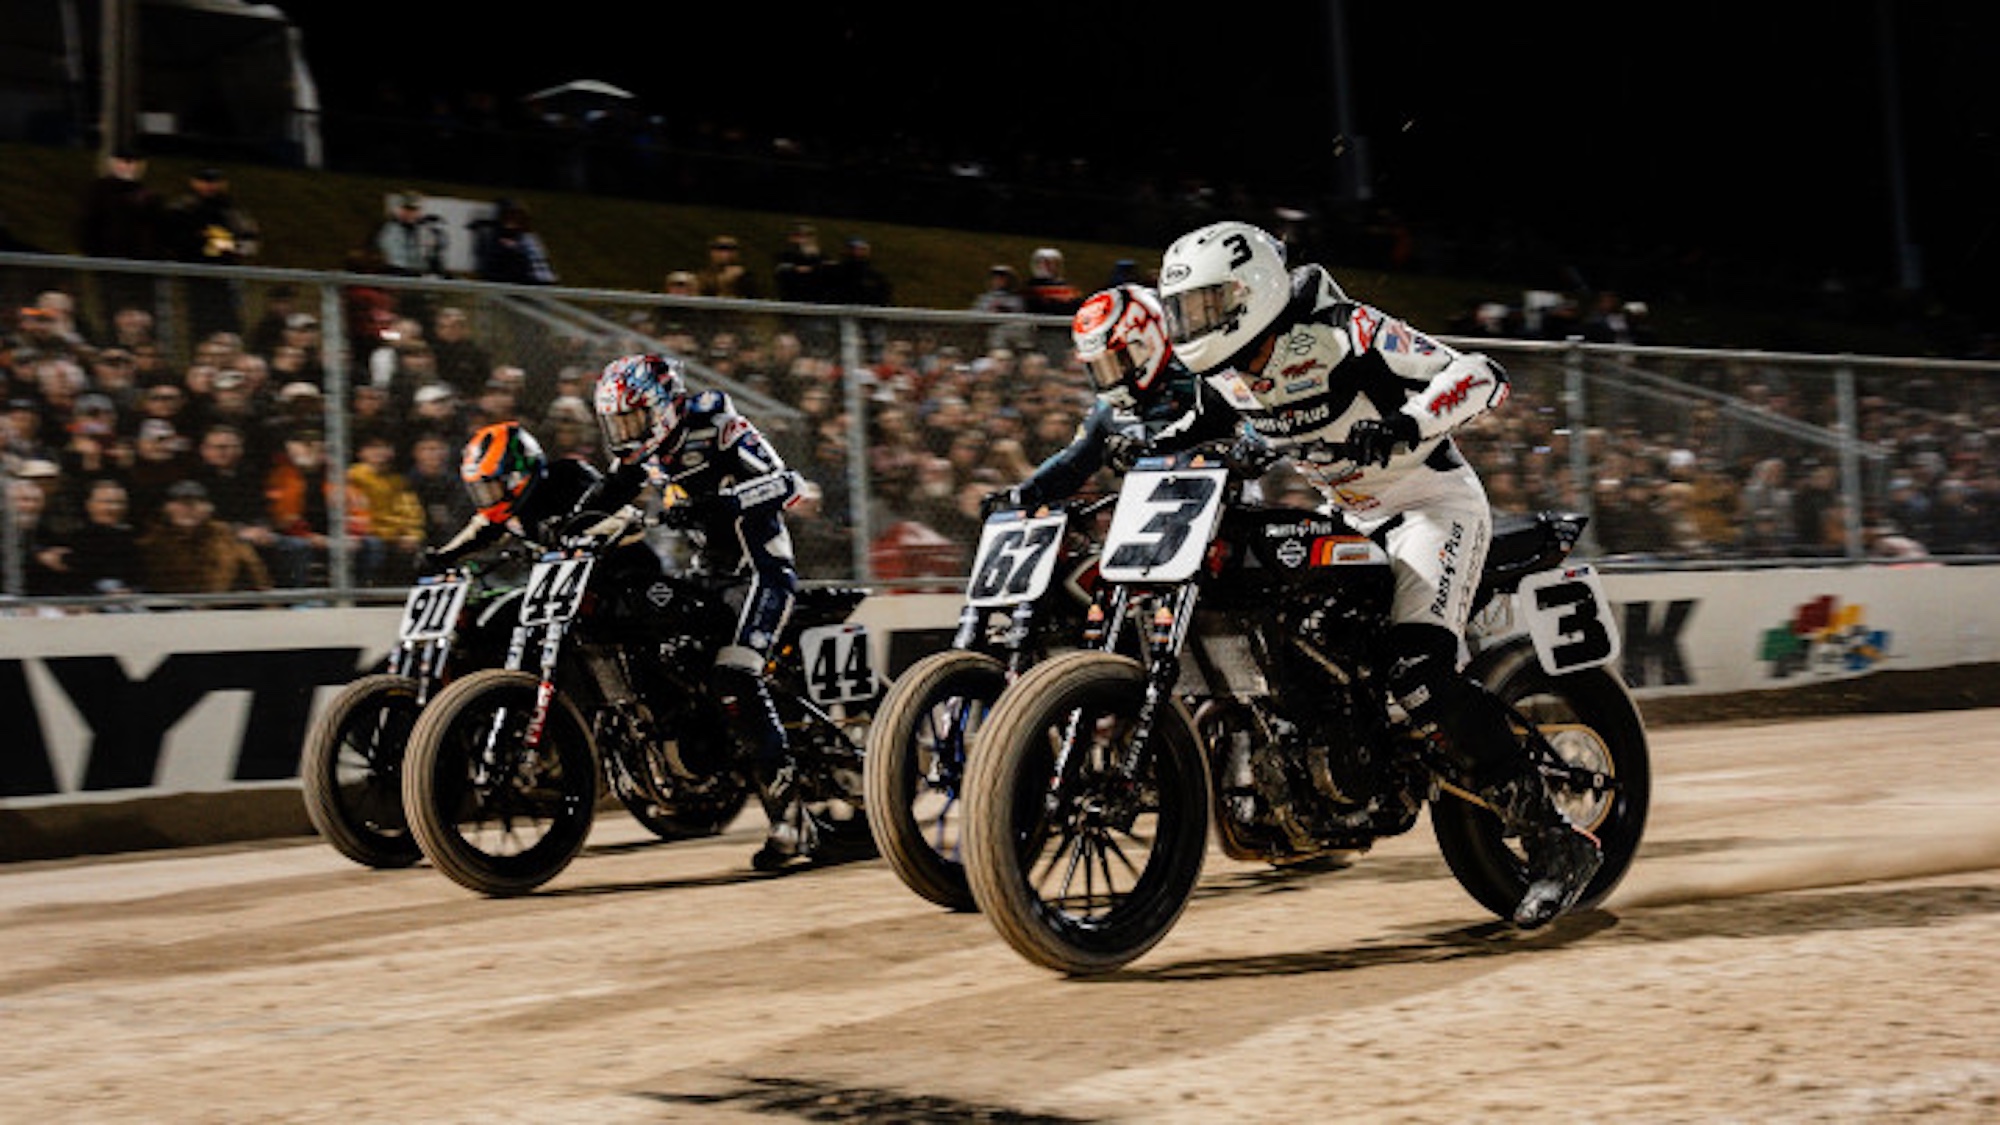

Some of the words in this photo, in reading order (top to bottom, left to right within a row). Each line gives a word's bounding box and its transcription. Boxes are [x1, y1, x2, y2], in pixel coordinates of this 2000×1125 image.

[1223, 233, 1252, 270] 3
[1104, 477, 1216, 568] 3
[521, 560, 595, 622] 44
[970, 525, 1060, 600] 67
[405, 586, 457, 636] 911
[1534, 580, 1611, 669] 3
[811, 633, 872, 700] 44
